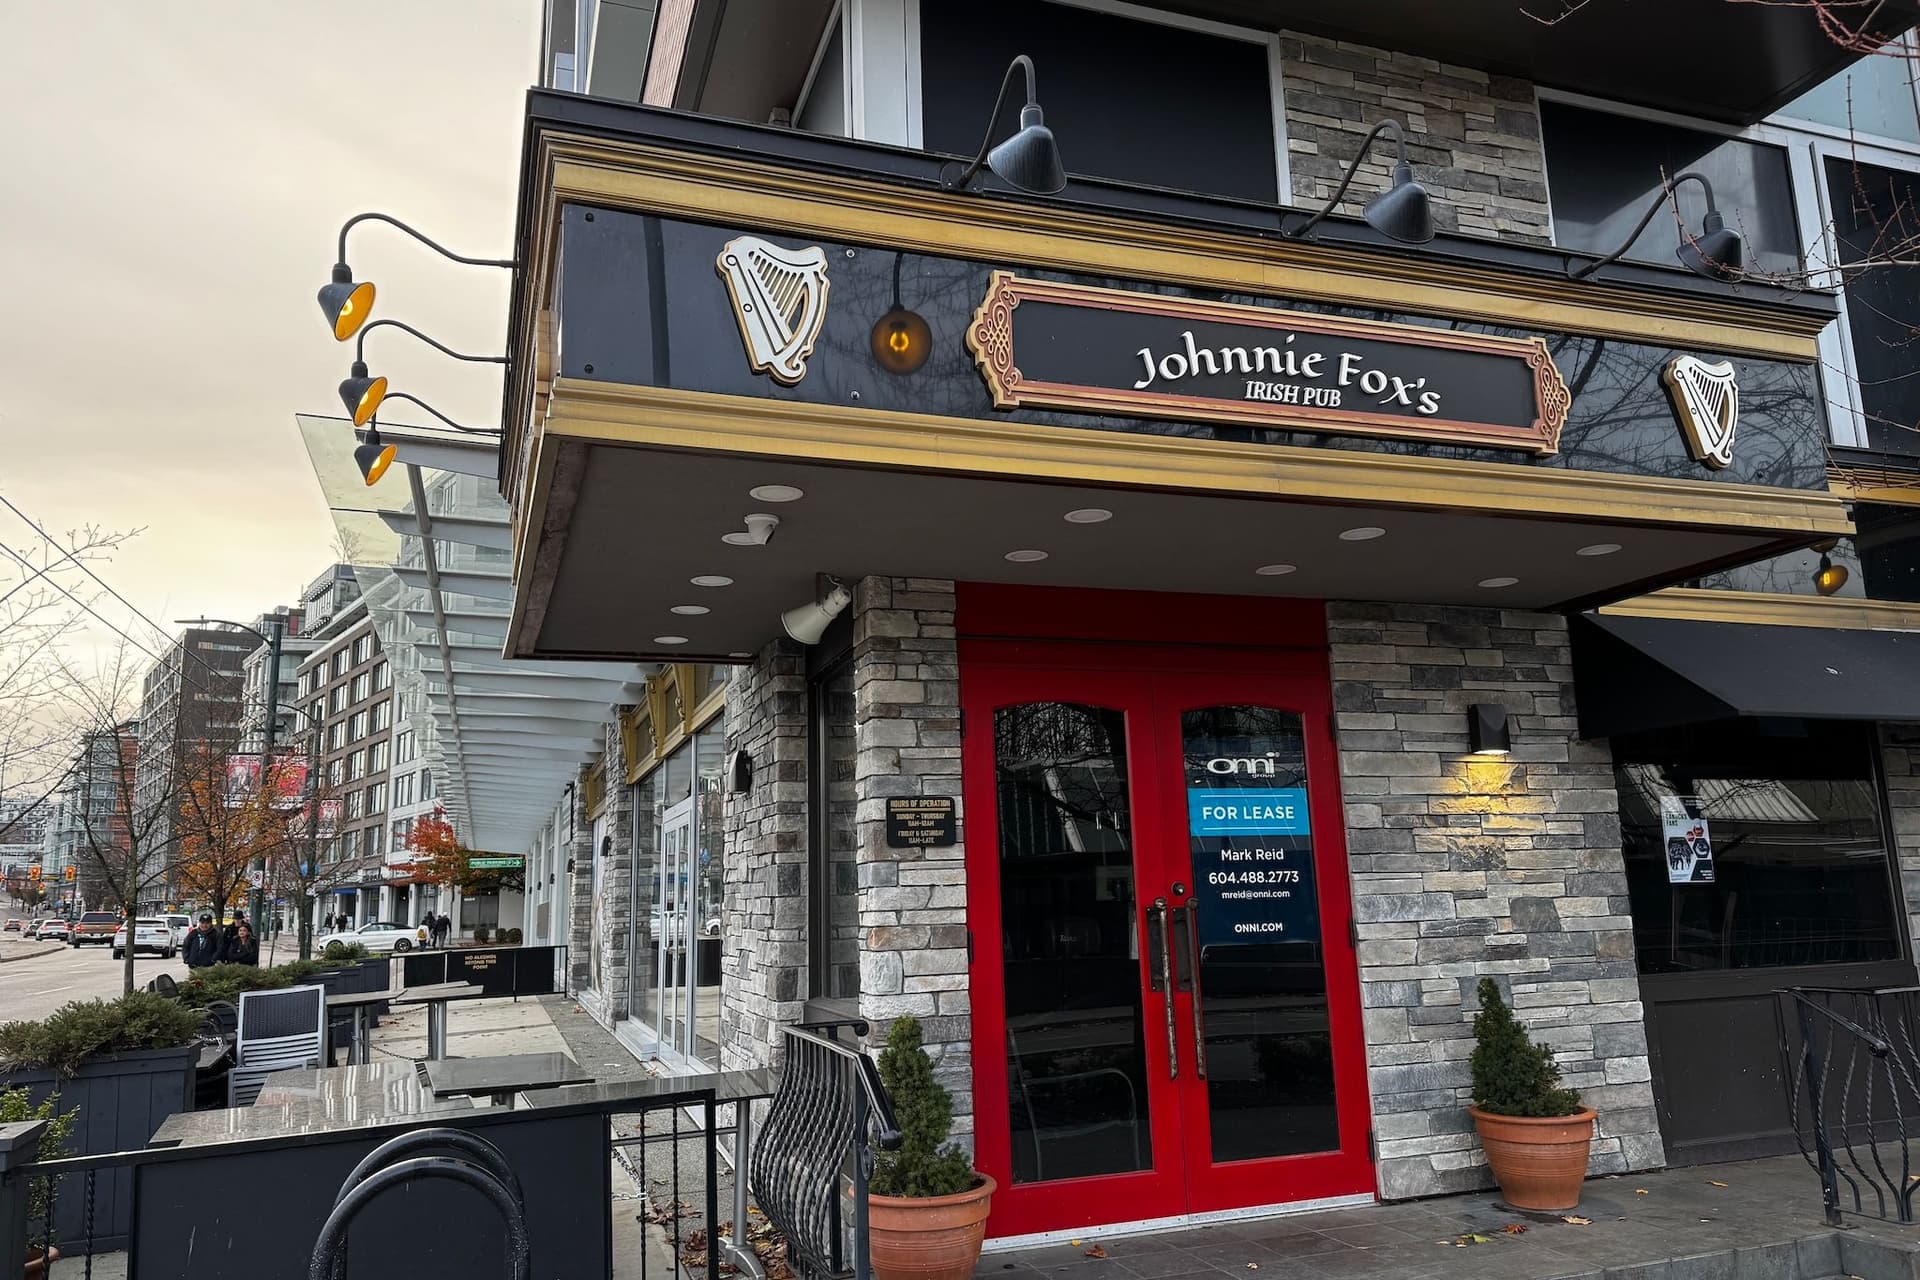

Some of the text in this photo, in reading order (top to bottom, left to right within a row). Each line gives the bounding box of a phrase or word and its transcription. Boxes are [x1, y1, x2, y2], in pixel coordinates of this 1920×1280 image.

[1134, 331, 1441, 414] Johnnie Fox's
[1245, 380, 1341, 407] IRISH PUB
[1207, 752, 1276, 774] onni
[890, 800, 909, 808] HOURS
[919, 799, 951, 807] OPERATION
[1203, 806, 1294, 819] FOR LEASE
[1221, 848, 1284, 861] Mark Reid
[1208, 870, 1300, 885] 604.488.2773
[1221, 889, 1290, 899] mreid@onni.com
[1234, 922, 1283, 933] ONNI.COM
